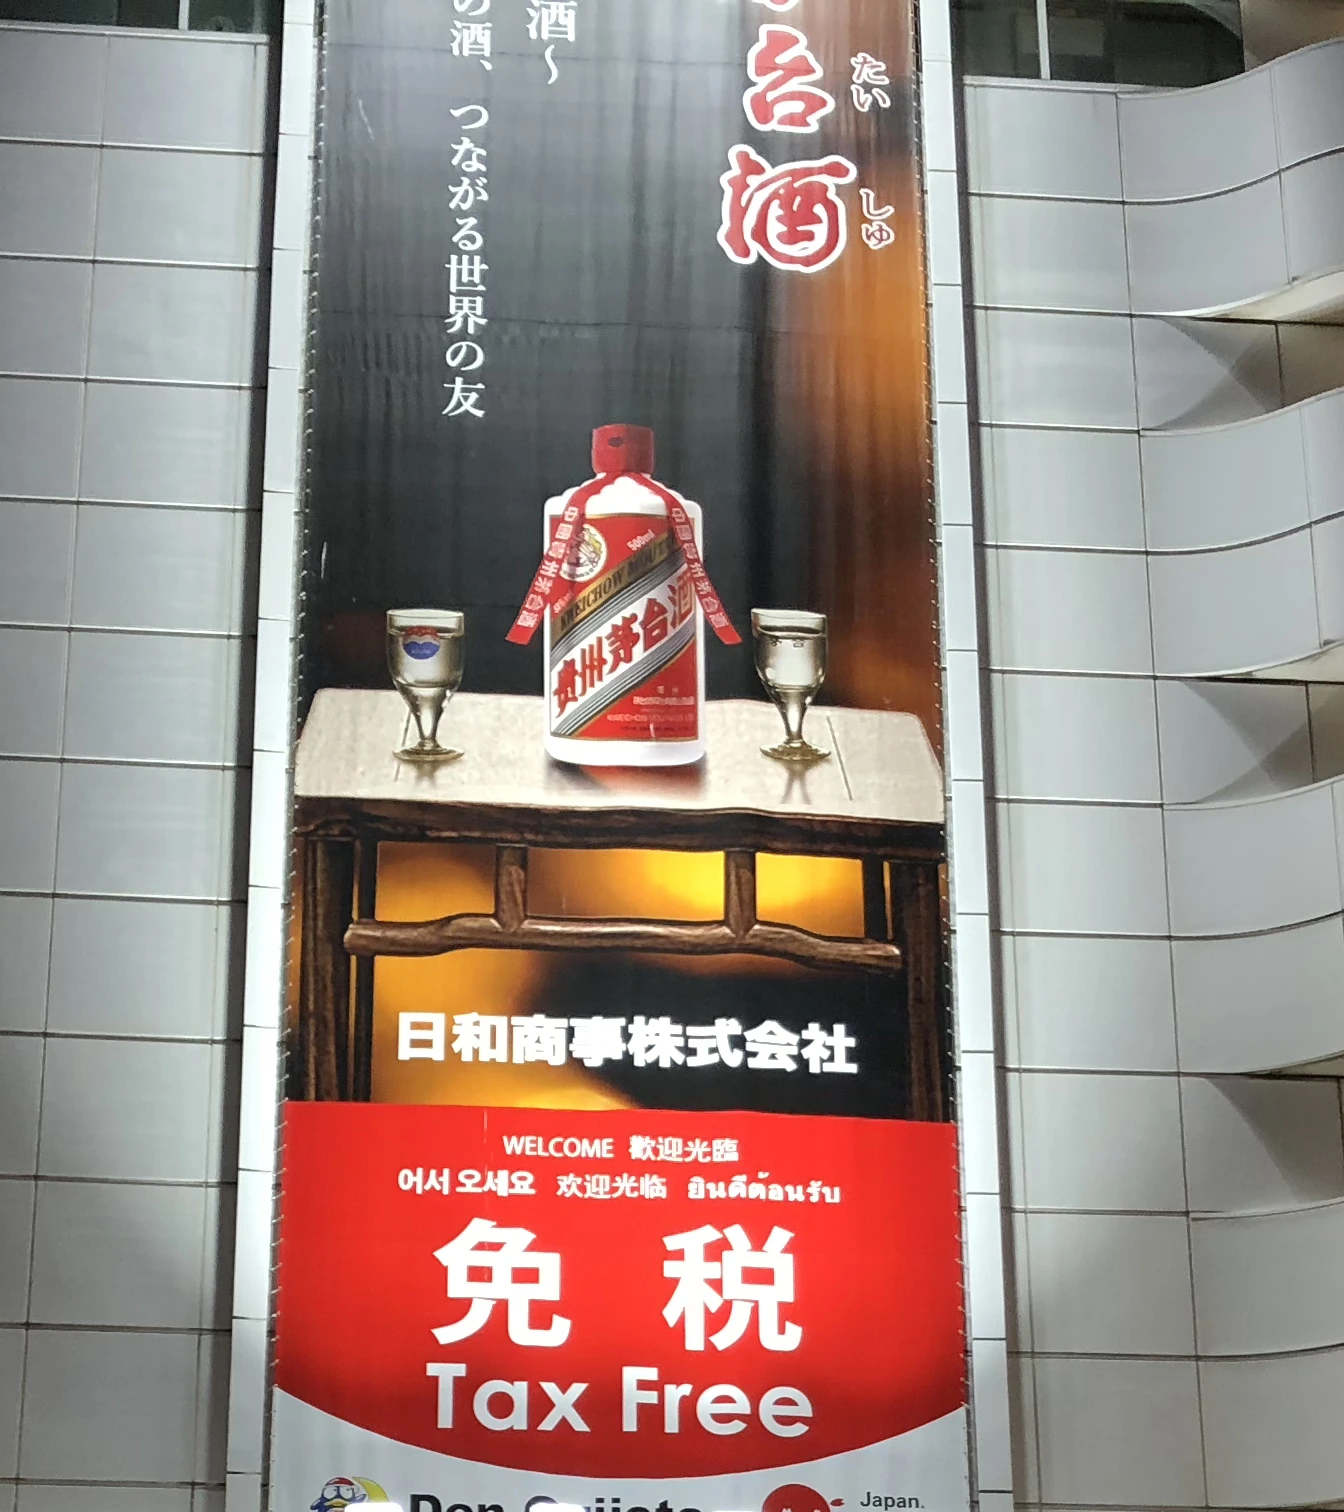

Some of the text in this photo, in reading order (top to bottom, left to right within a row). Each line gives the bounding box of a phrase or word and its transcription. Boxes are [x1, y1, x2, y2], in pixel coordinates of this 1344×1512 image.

[717, 0, 856, 272] 台酒
[442, 104, 490, 418] つながる世界の友
[396, 1012, 858, 1075] 日和商事株式会社
[502, 1135, 614, 1159] WELCOME
[555, 1173, 667, 1200] 欢迎光临
[425, 1362, 814, 1438] Tax Free
